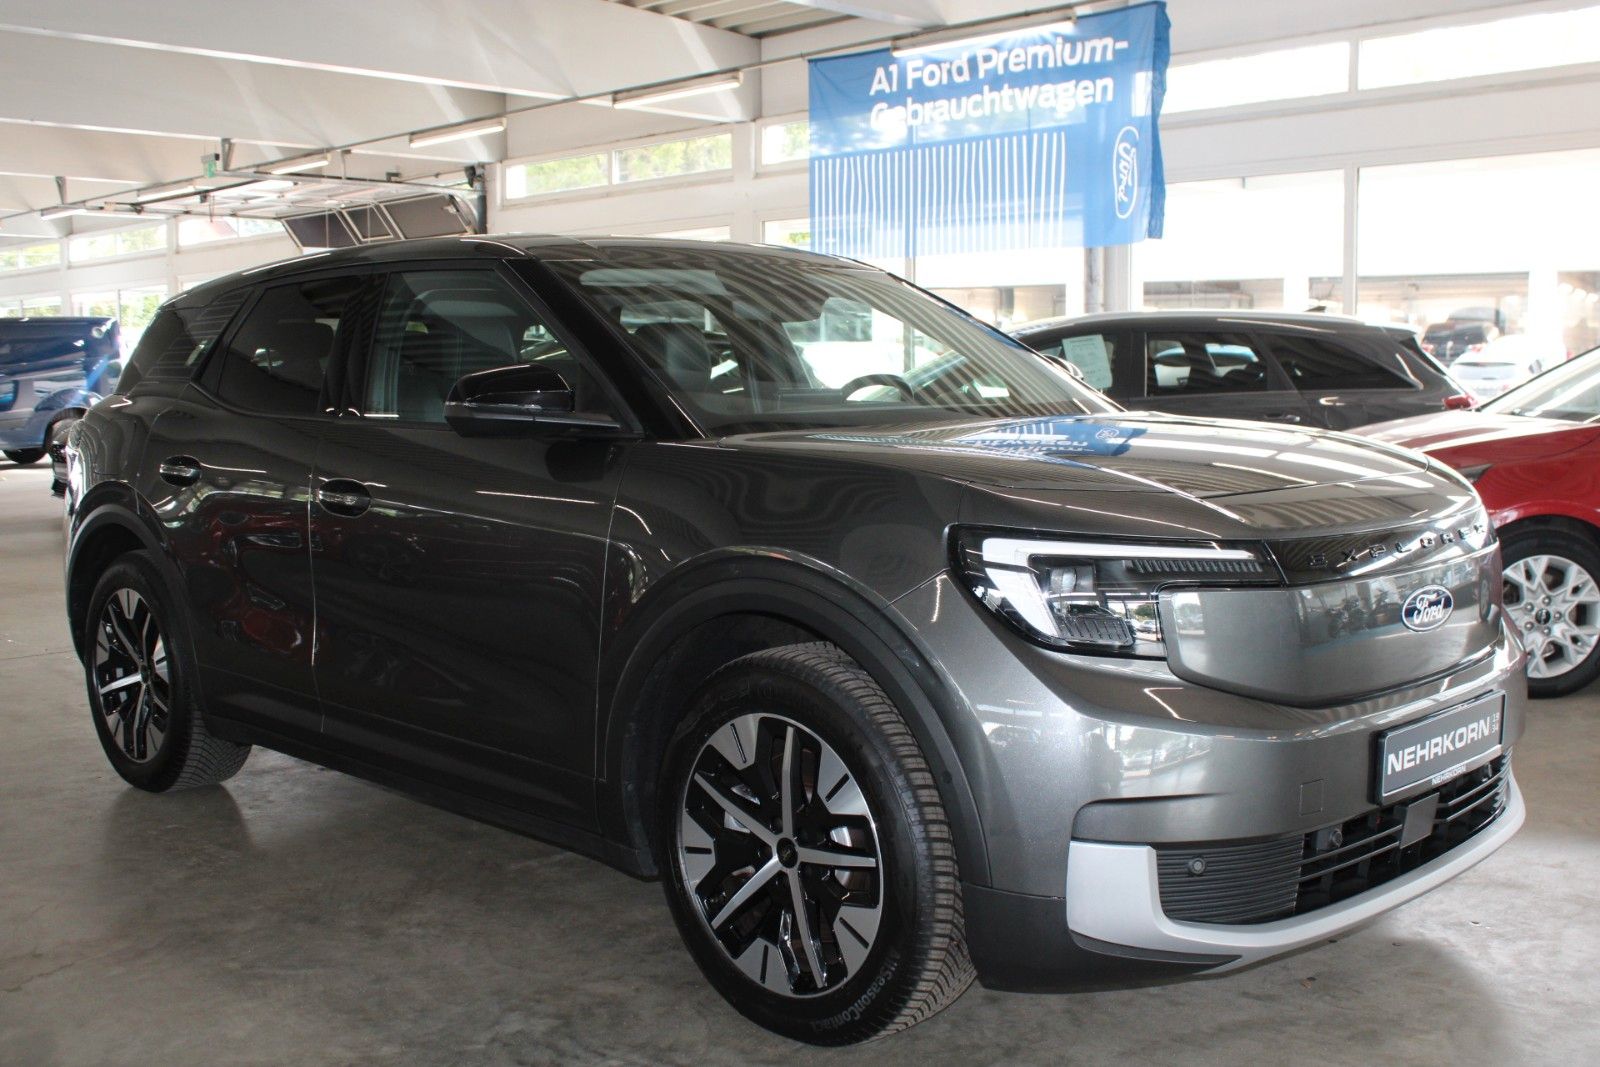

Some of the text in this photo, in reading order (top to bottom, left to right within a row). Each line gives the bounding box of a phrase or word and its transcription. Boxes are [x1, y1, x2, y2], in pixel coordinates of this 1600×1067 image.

[869, 35, 1128, 97] A1 Ford Premium-
[870, 76, 1114, 128] Gebrauchtwagen
[1309, 524, 1486, 569] EXPLORER
[1386, 716, 1491, 776] NEHRKORN
